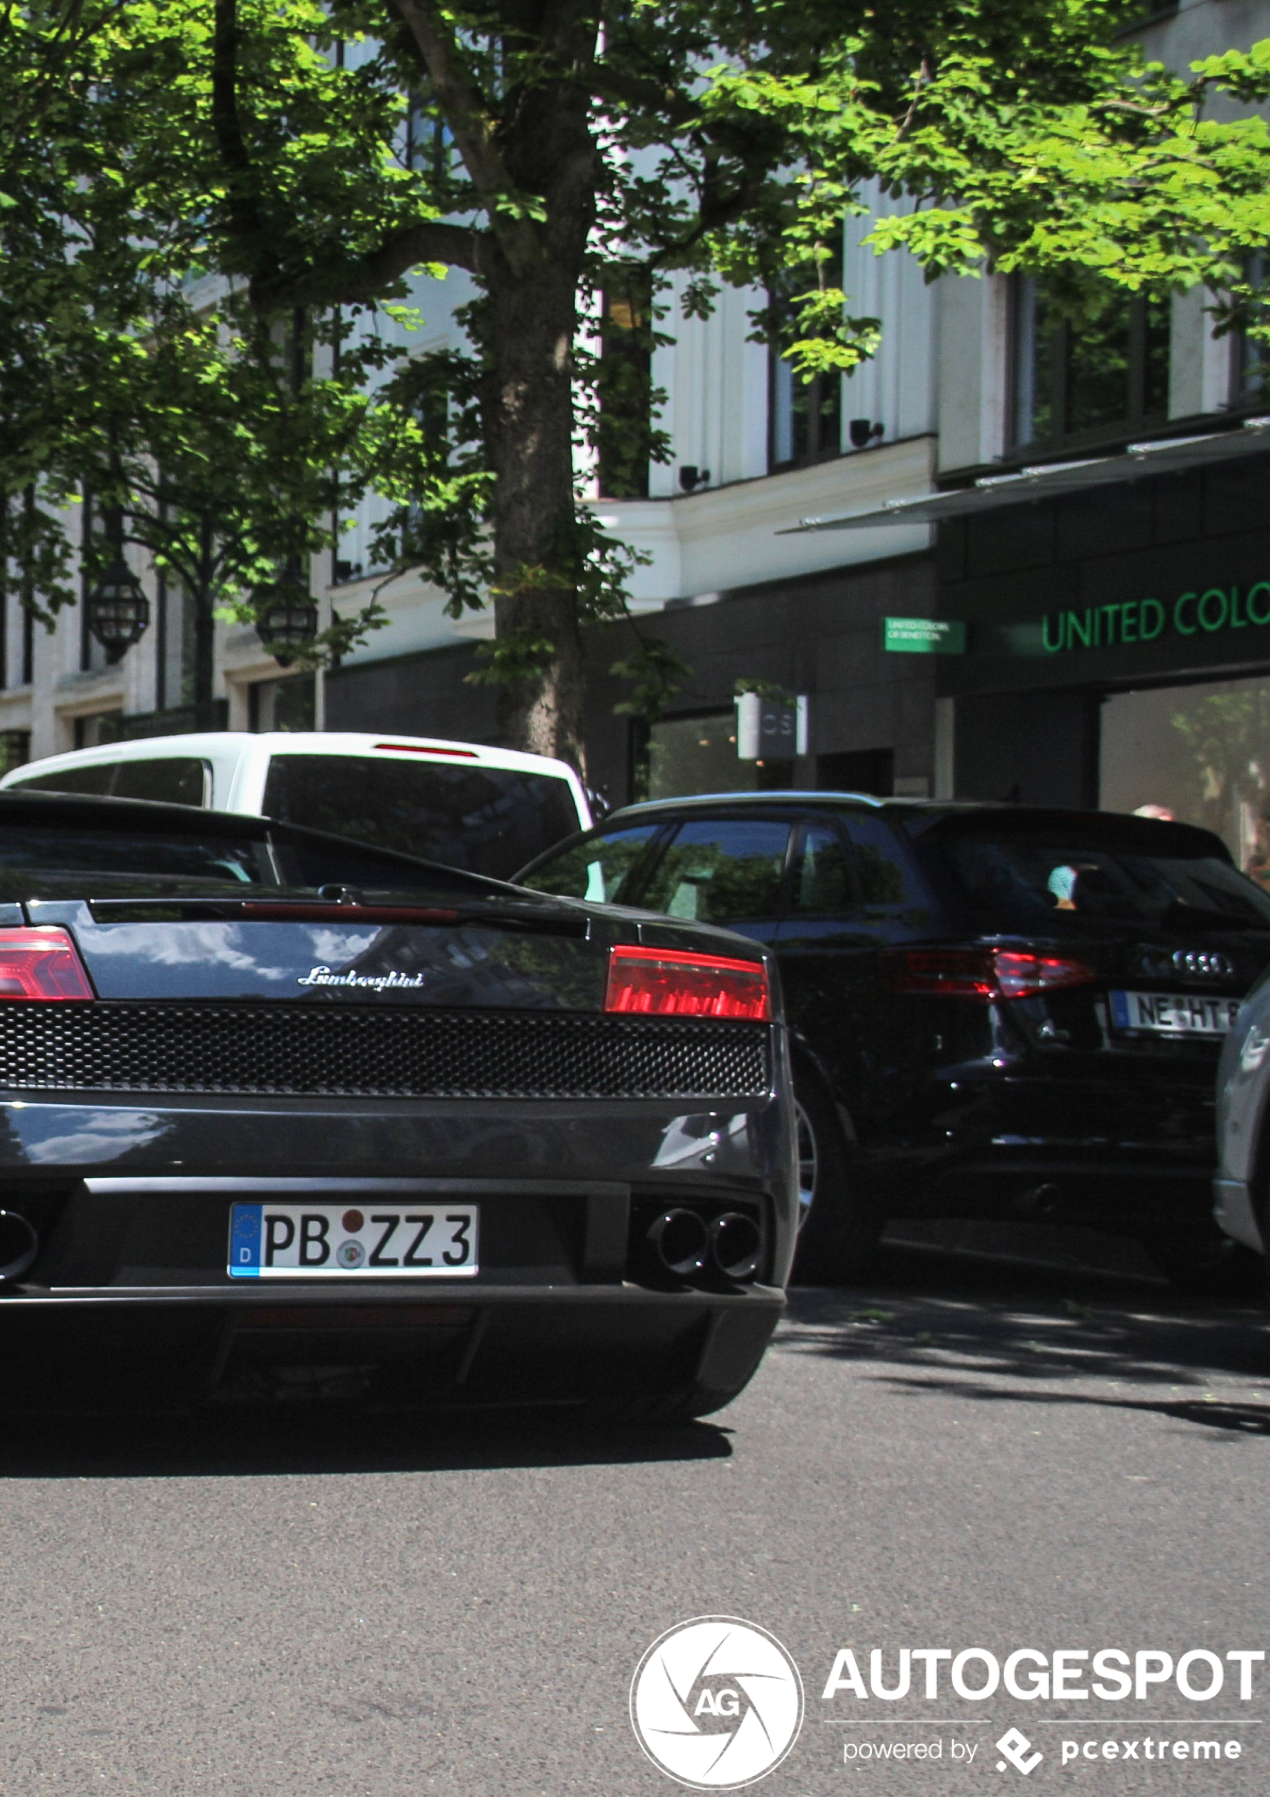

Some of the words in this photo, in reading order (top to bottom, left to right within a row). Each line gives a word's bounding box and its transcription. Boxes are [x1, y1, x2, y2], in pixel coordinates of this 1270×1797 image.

[1042, 599, 1165, 652] UNITED
[1173, 582, 1270, 635] COLO
[297, 965, 424, 992] Lamborghini
[1137, 997, 1173, 1025] NE
[1188, 999, 1220, 1029] HT
[239, 1248, 252, 1262] D
[263, 1214, 331, 1267] PB
